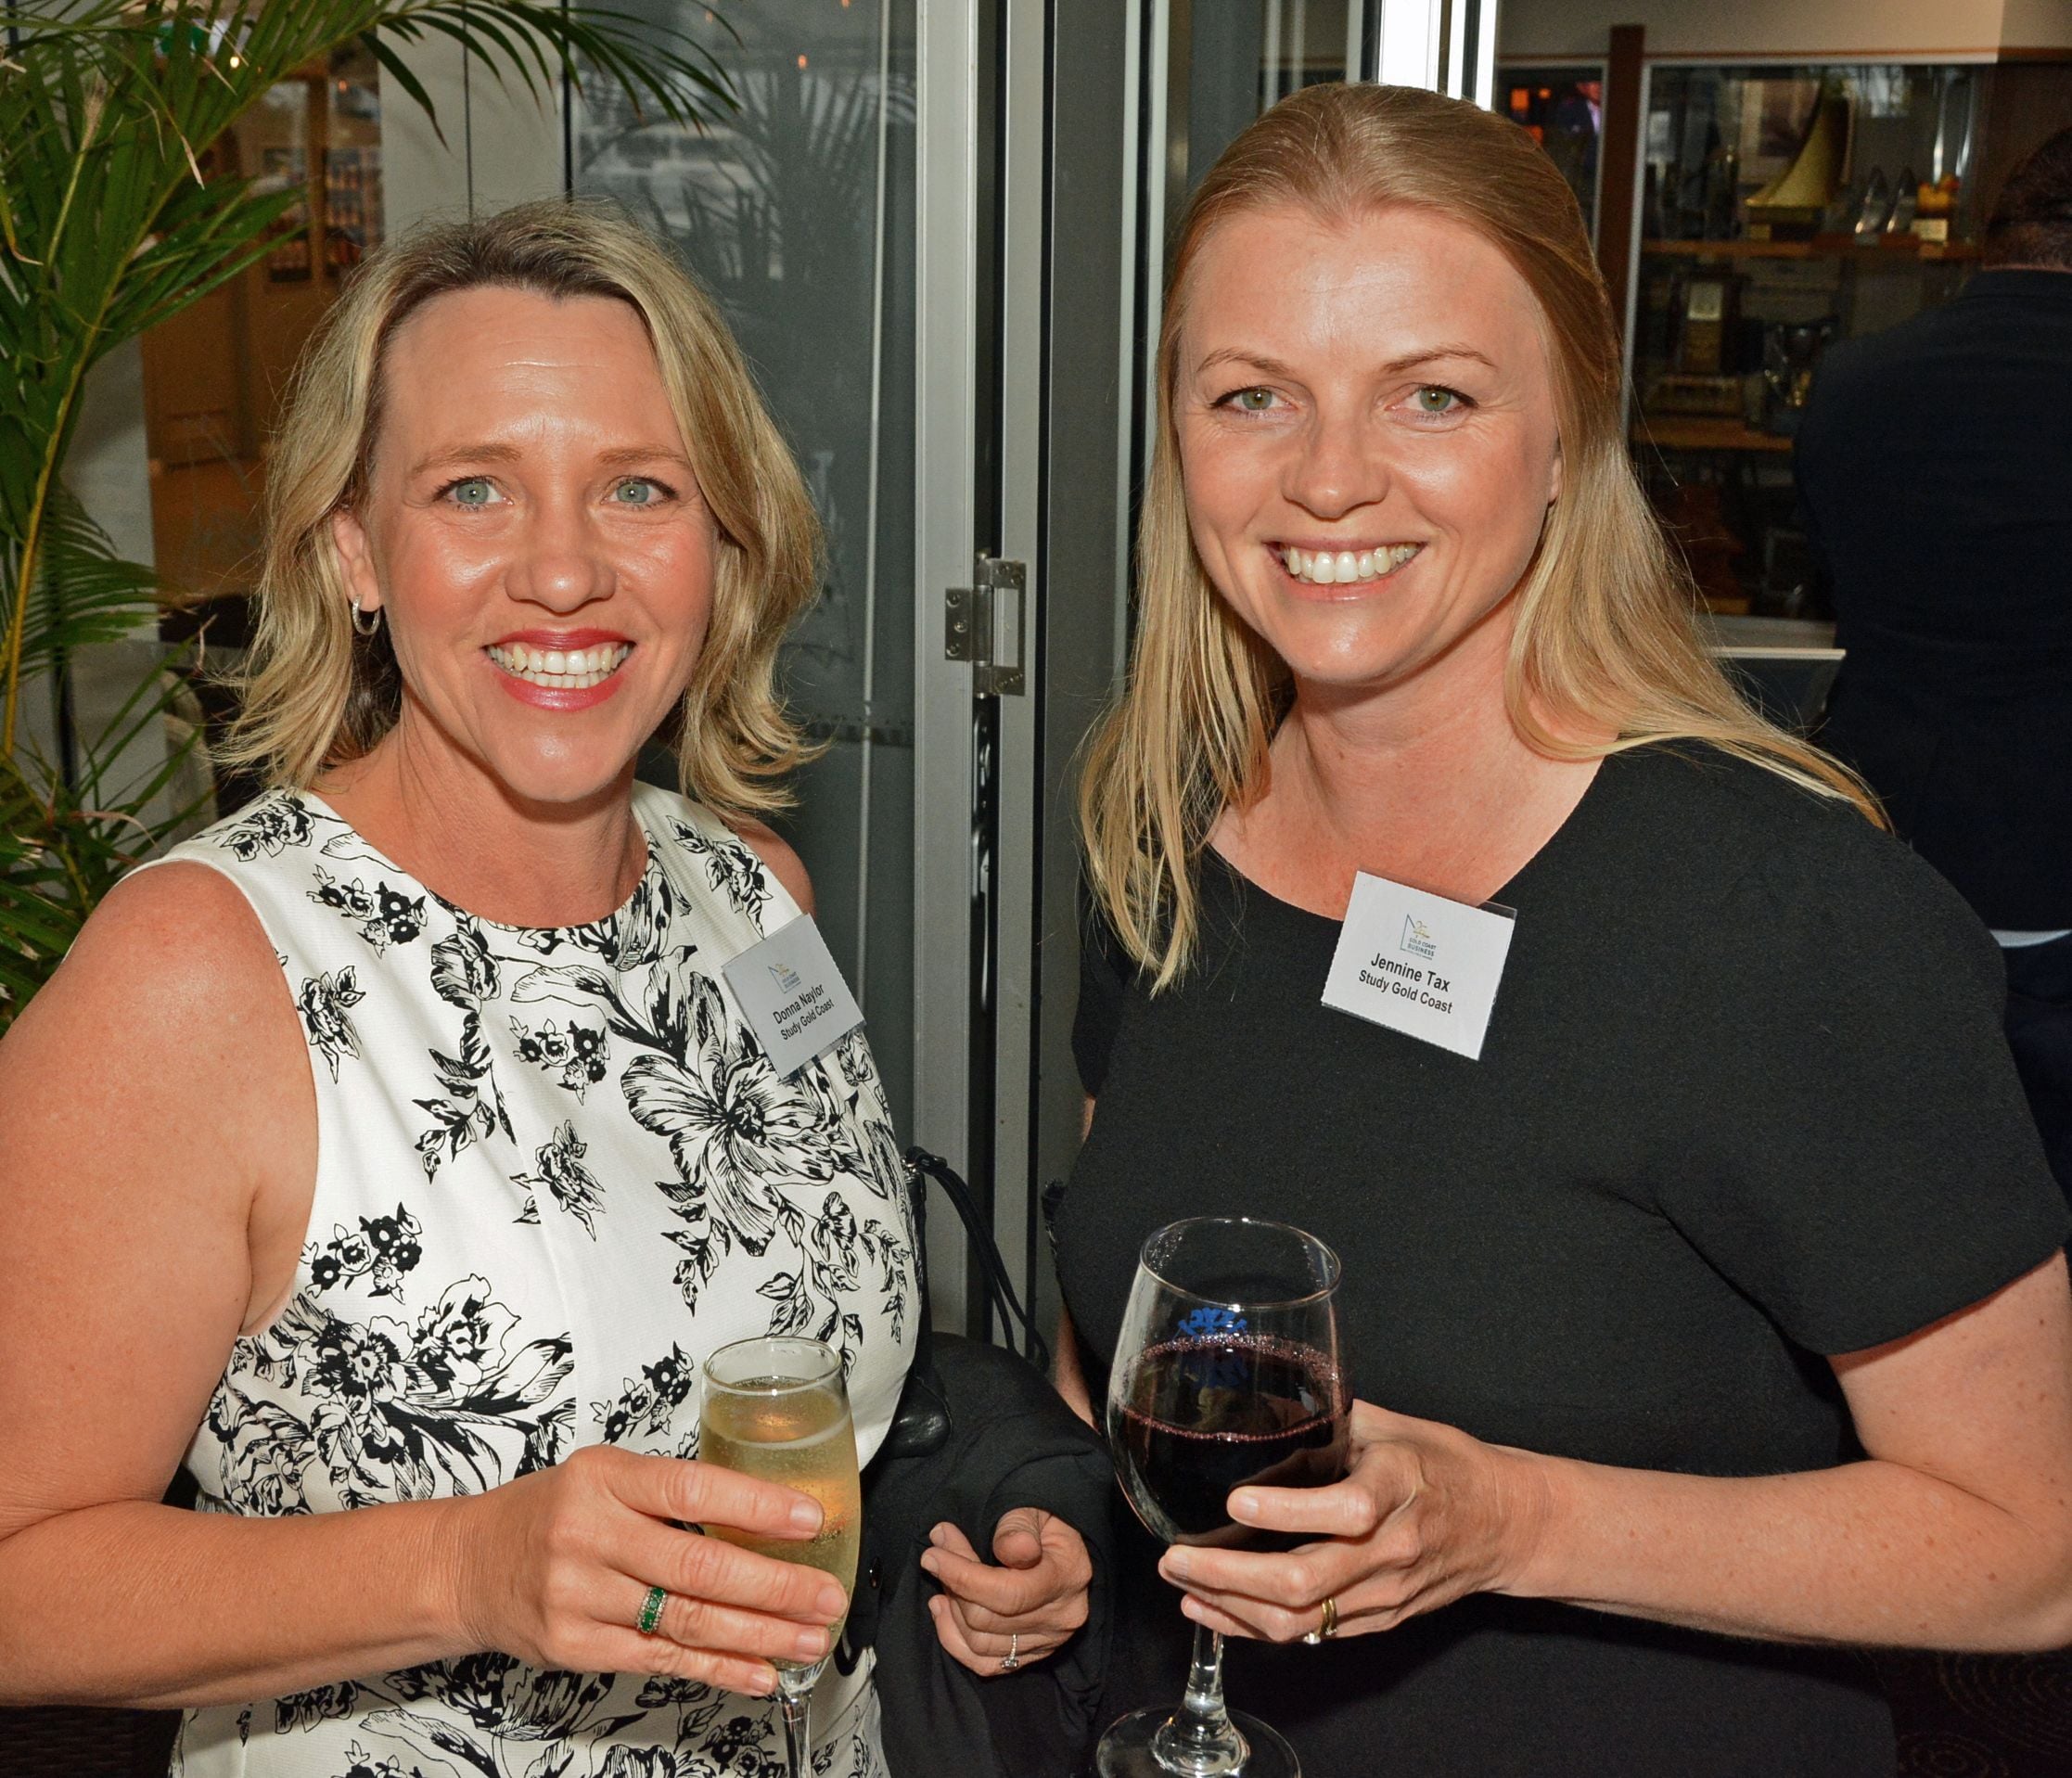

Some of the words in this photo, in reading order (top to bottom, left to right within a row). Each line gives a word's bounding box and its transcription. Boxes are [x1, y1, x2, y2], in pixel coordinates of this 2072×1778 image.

[1407, 943, 1435, 956] BUSINESS
[1359, 969, 1389, 993] Study
[1392, 981, 1418, 1002] Gold
[1420, 991, 1452, 1014] Coast
[1371, 953, 1422, 982] Jennine
[1427, 970, 1451, 992] Tax
[773, 1001, 801, 1024] Donna
[799, 984, 825, 1005] Naylor
[781, 1020, 802, 1041] Study
[799, 1009, 816, 1027] Gold
[815, 998, 835, 1017] Coast
